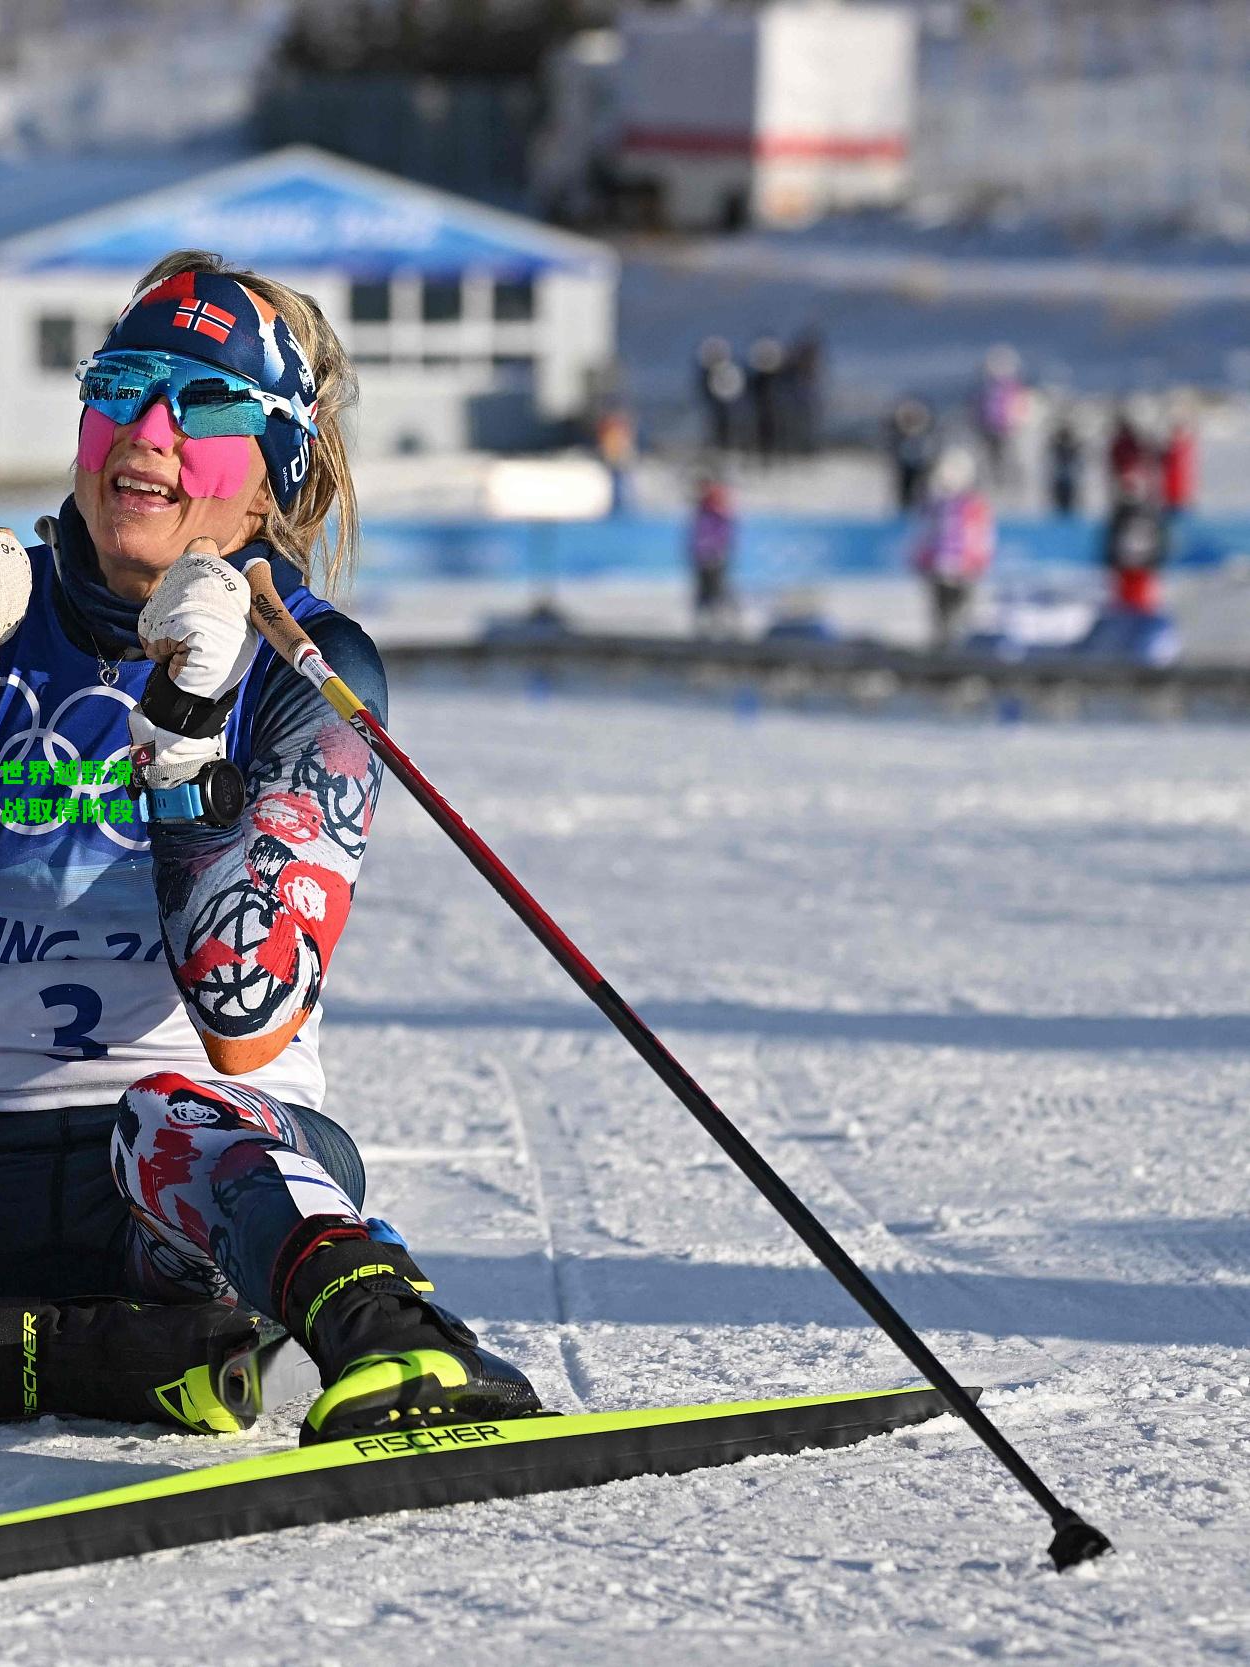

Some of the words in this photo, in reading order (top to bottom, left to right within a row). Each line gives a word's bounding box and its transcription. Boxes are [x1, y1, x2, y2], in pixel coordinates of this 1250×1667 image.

[38, 983, 109, 1063] 3
[305, 1263, 396, 1345] FISCHER
[353, 1424, 508, 1458] FISCHER
